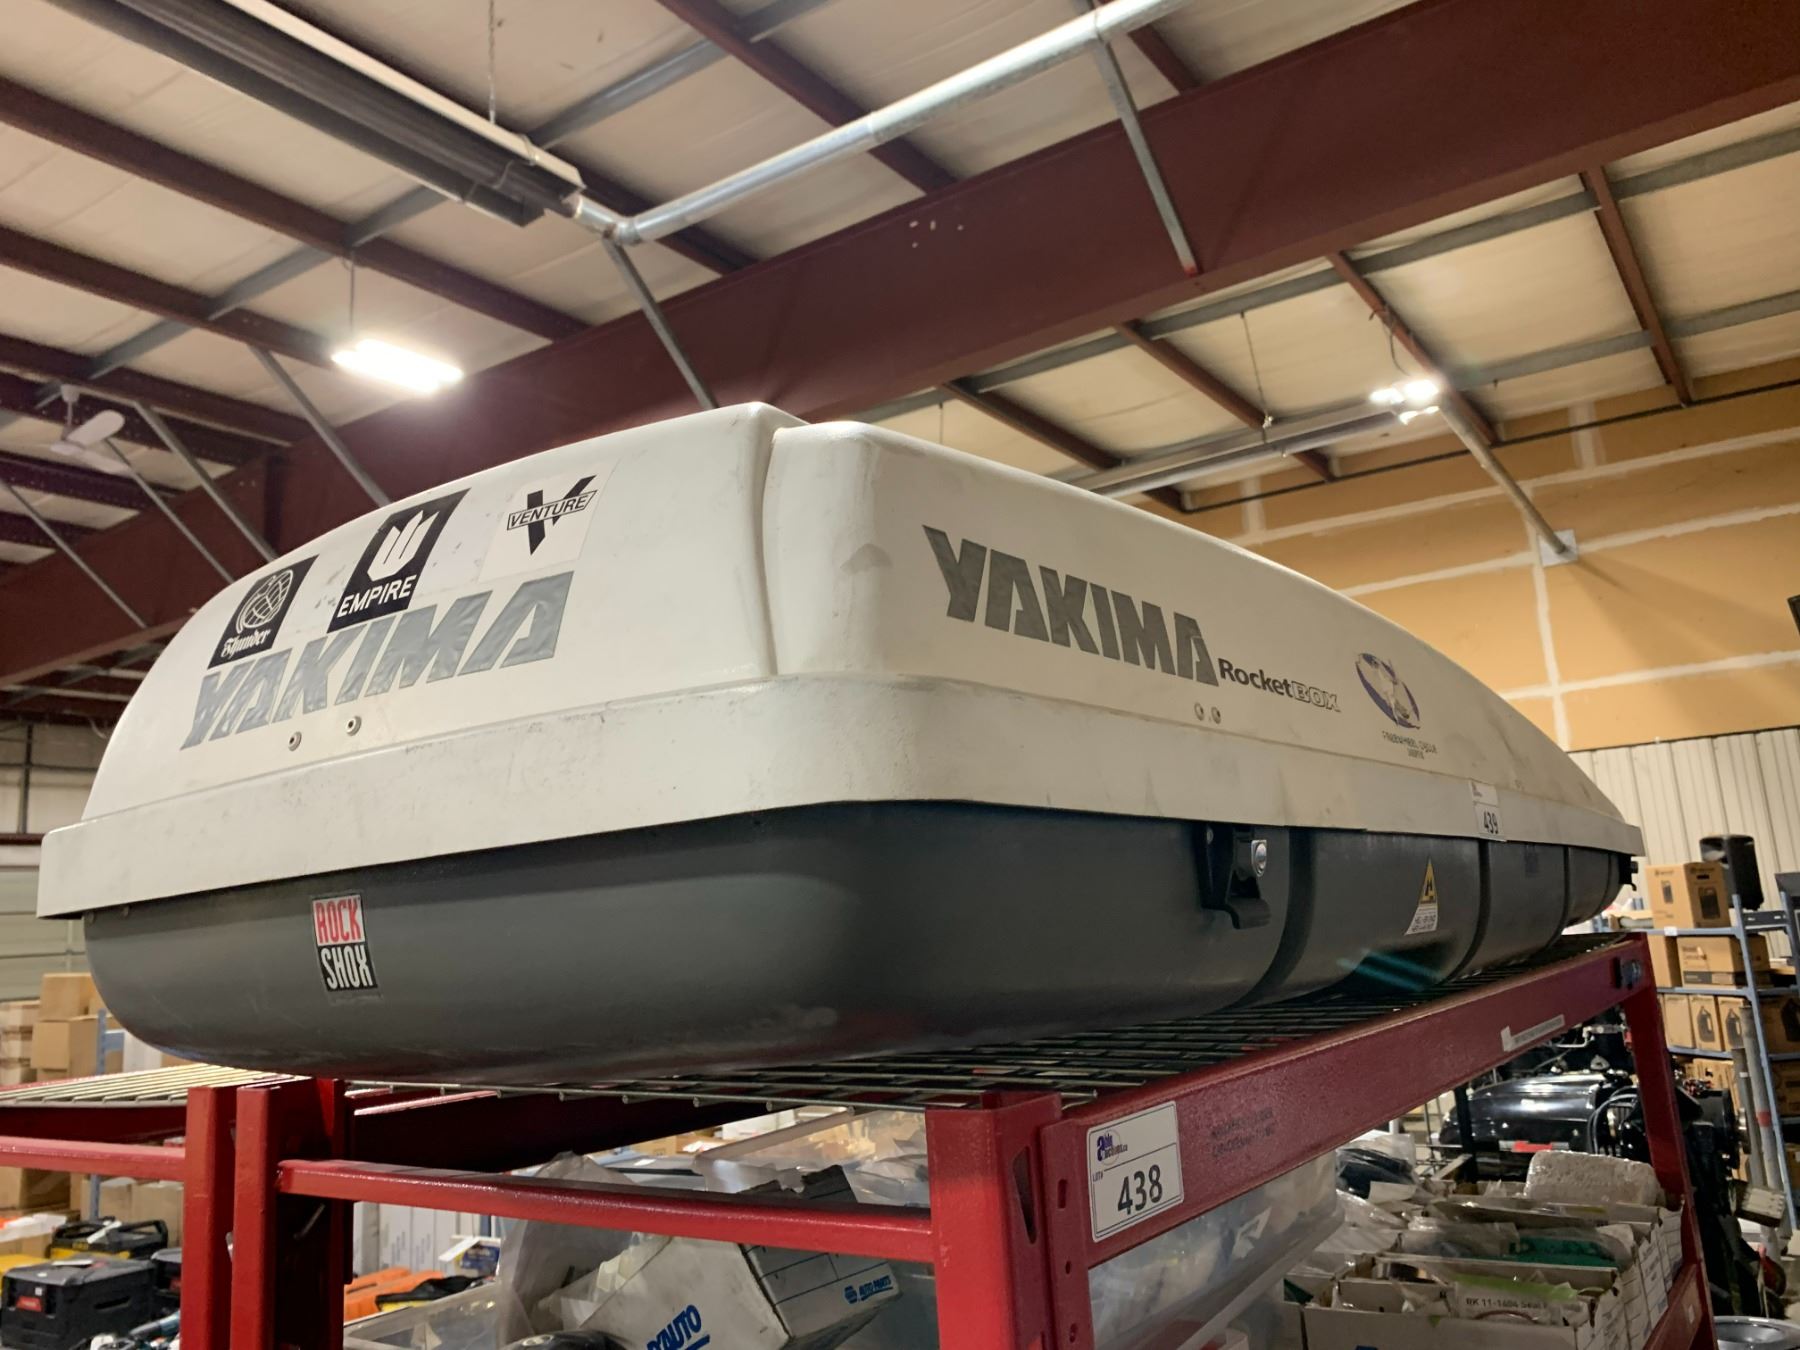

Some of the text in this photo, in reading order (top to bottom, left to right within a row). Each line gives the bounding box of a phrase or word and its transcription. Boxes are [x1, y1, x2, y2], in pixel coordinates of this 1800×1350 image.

[511, 494, 589, 528] VENTURE
[336, 574, 418, 618] EMPIRE
[921, 524, 1219, 687] YAKIMA
[180, 570, 575, 751] YAKIMA
[1483, 810, 1499, 835] 439
[315, 898, 362, 944] ROCK
[320, 945, 374, 989] SHOX
[1117, 1164, 1163, 1215] 438
